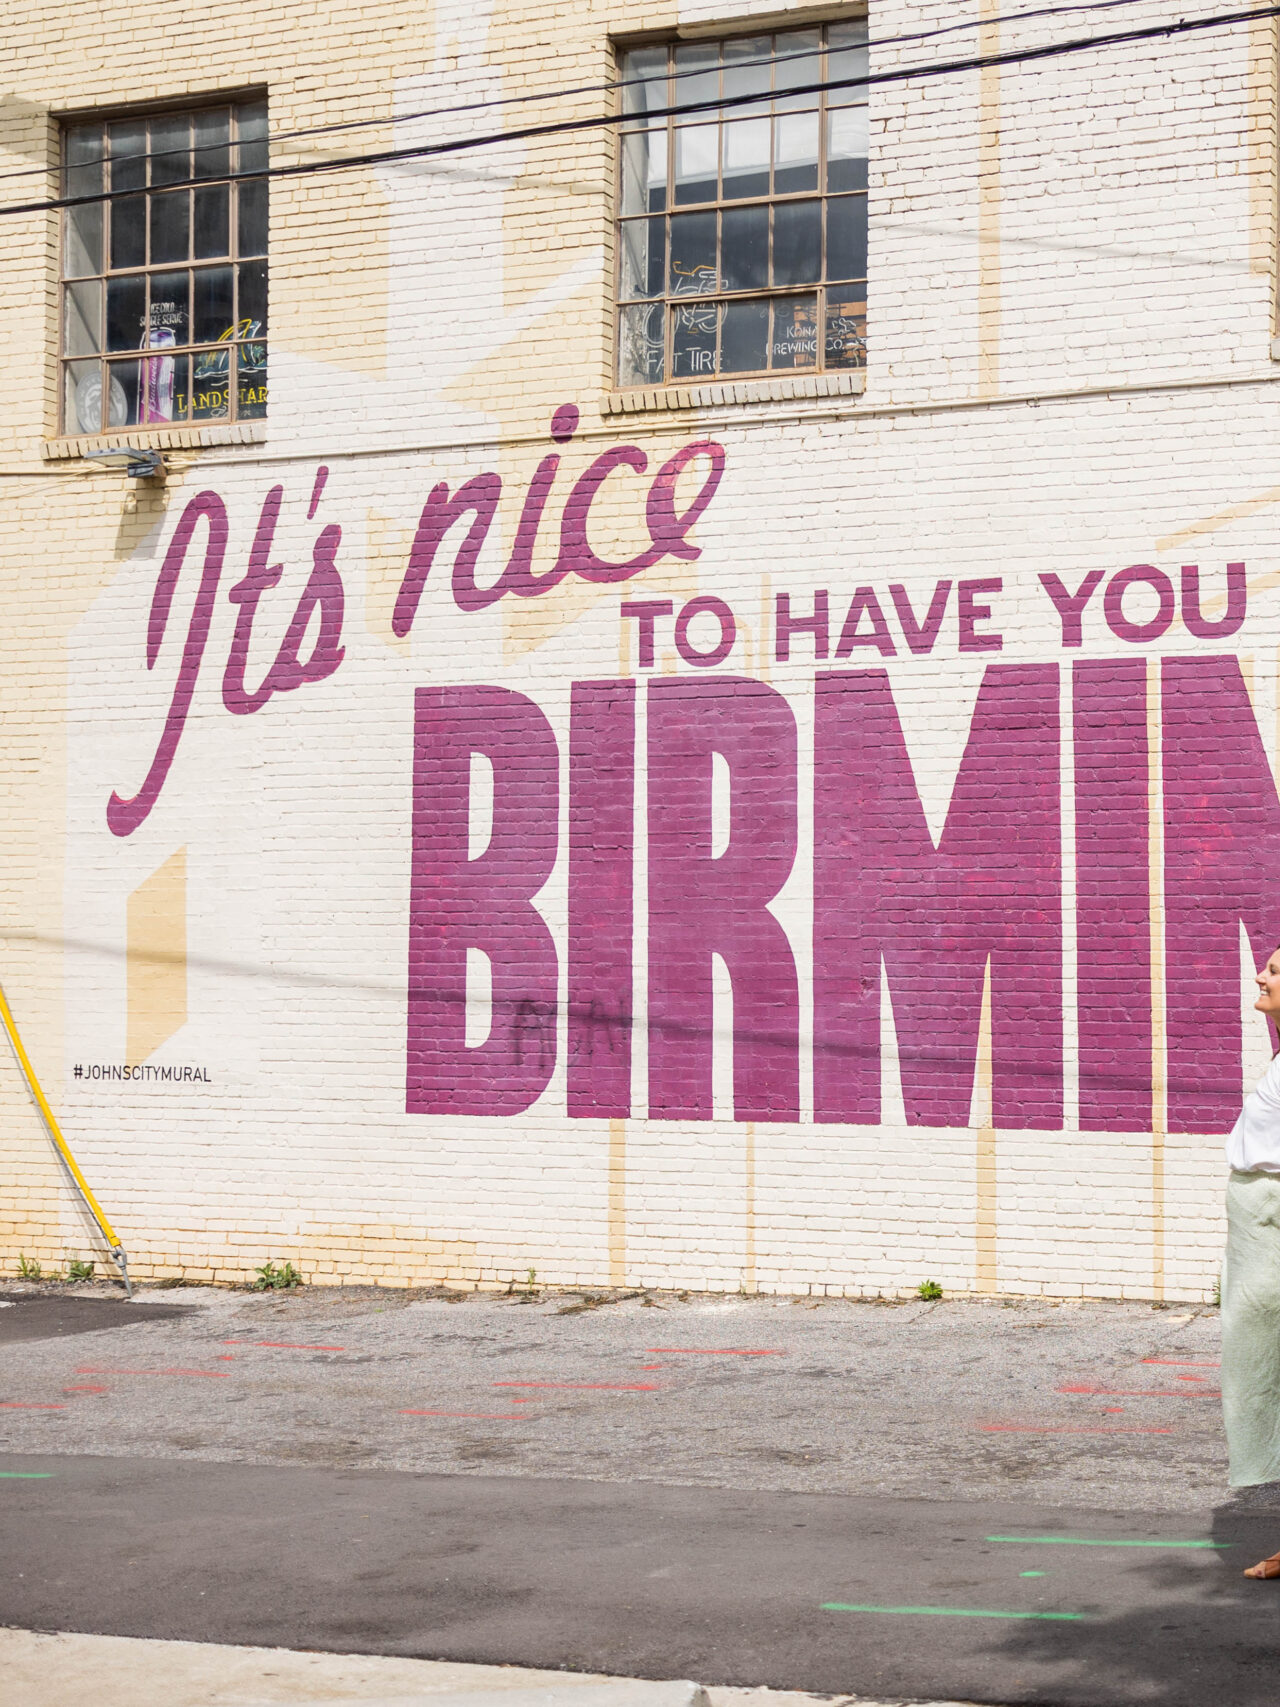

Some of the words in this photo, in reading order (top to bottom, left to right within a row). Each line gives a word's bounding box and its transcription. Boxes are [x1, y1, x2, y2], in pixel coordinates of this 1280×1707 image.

[139, 314, 162, 327] SGLE
[685, 346, 724, 372] TIRE
[176, 387, 269, 413] LANDSHAR
[106, 466, 346, 837] It's
[392, 403, 727, 637] nice
[621, 595, 736, 668] TO
[774, 577, 1003, 662] HAVE
[1037, 562, 1248, 647] YOU
[73, 1064, 212, 1083] #JOHNSCITYMURAL
